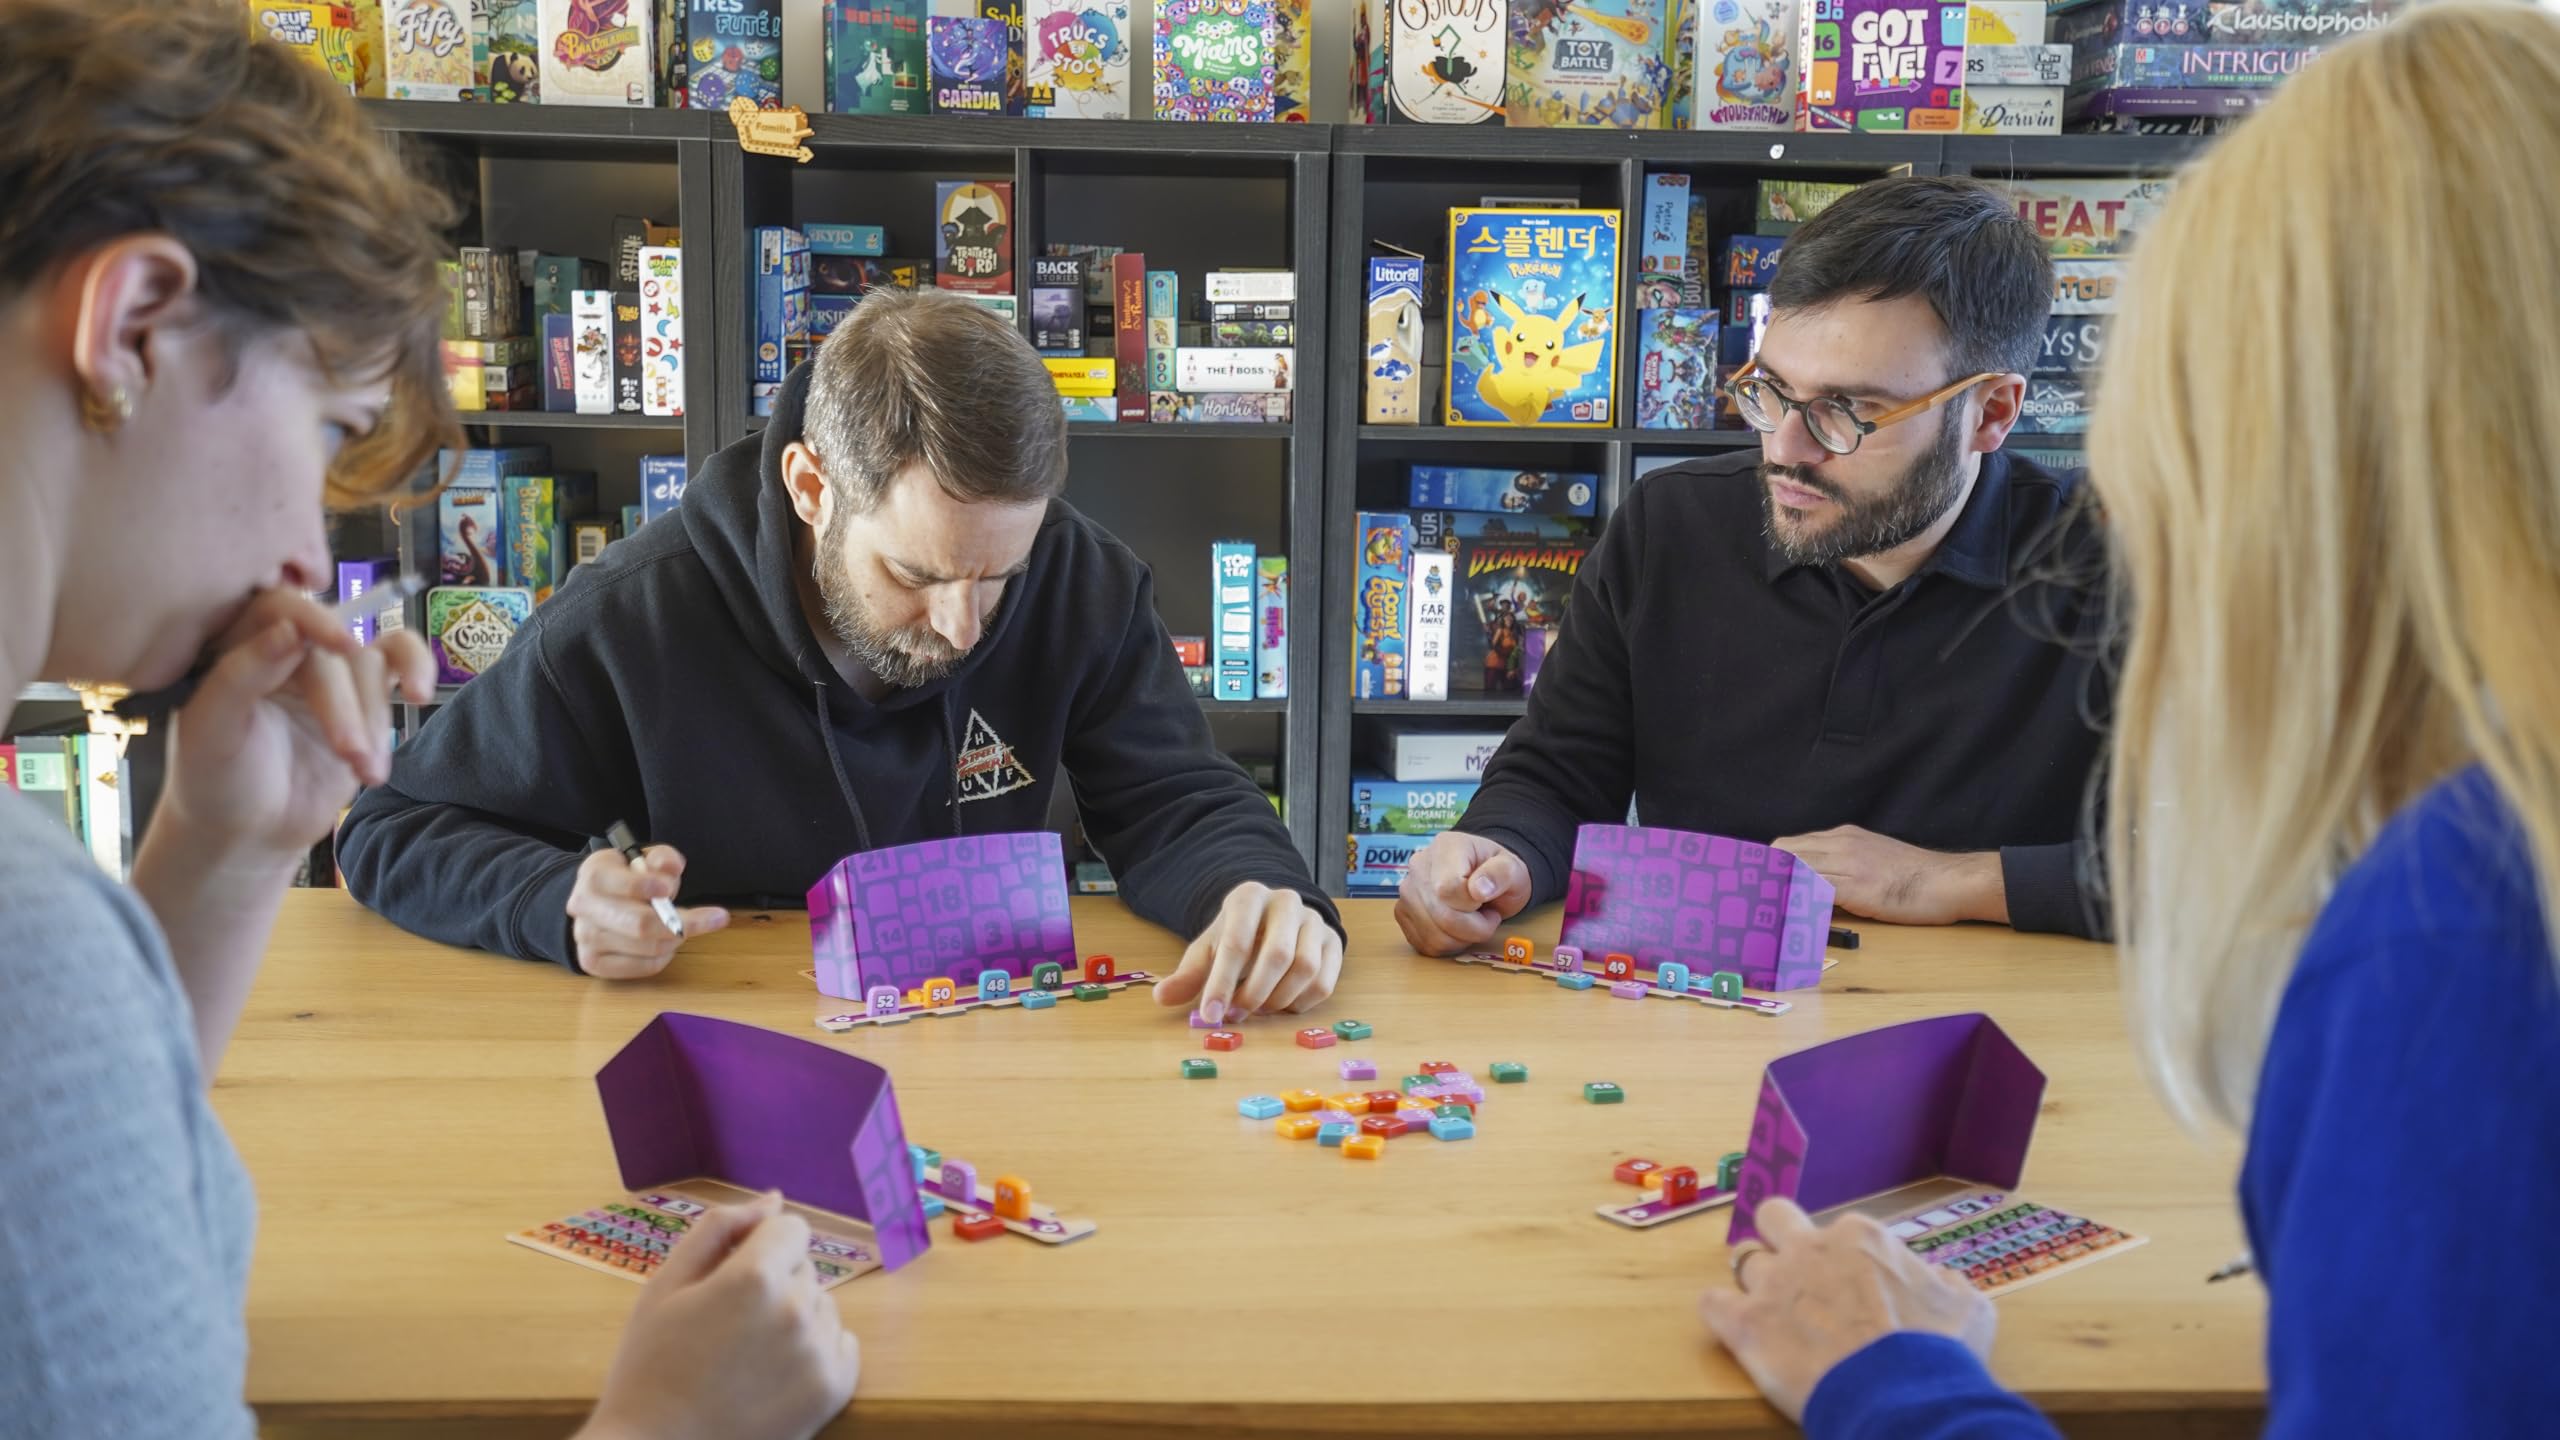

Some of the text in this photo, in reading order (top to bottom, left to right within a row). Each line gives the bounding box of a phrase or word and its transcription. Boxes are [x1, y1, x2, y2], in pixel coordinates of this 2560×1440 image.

[397, 3, 465, 57] Fifty
[1852, 9, 1928, 47] GOT
[1048, 25, 1108, 49] TRUCS
[1815, 34, 1835, 51] 16
[1173, 34, 1259, 70] Miams
[1566, 41, 1603, 57] TOY
[1560, 56, 1608, 70] BATTLE
[1945, 61, 1958, 79] 7
[1966, 59, 1984, 72] RS
[938, 88, 1001, 111] CARDIA
[1980, 103, 2055, 129] Darwin
[756, 122, 791, 134] Famille
[1467, 225, 1598, 260] 스플렌더
[1036, 261, 1079, 275] BACK
[1375, 267, 1419, 282] Littoral
[1206, 366, 1264, 375] THE BOSS
[1222, 553, 1253, 568] TOP
[1468, 549, 1584, 579] DIAMANT
[1223, 567, 1249, 578] TEN
[1383, 579, 1404, 640] LOONY
[1421, 603, 1445, 615] FAR
[454, 623, 505, 649] Codex
[975, 732, 984, 745] H
[1407, 791, 1458, 809] DORF
[925, 884, 962, 913] 18
[984, 922, 1002, 947] 3
[1507, 945, 1525, 959] 60
[1557, 954, 1573, 967] 57
[1608, 961, 1627, 975] 49
[1042, 971, 1058, 984] 41
[1096, 964, 1107, 976] 4
[1666, 970, 1676, 983] 3
[986, 979, 1006, 991] 48
[932, 987, 951, 1000] 50
[876, 995, 895, 1008] 52
